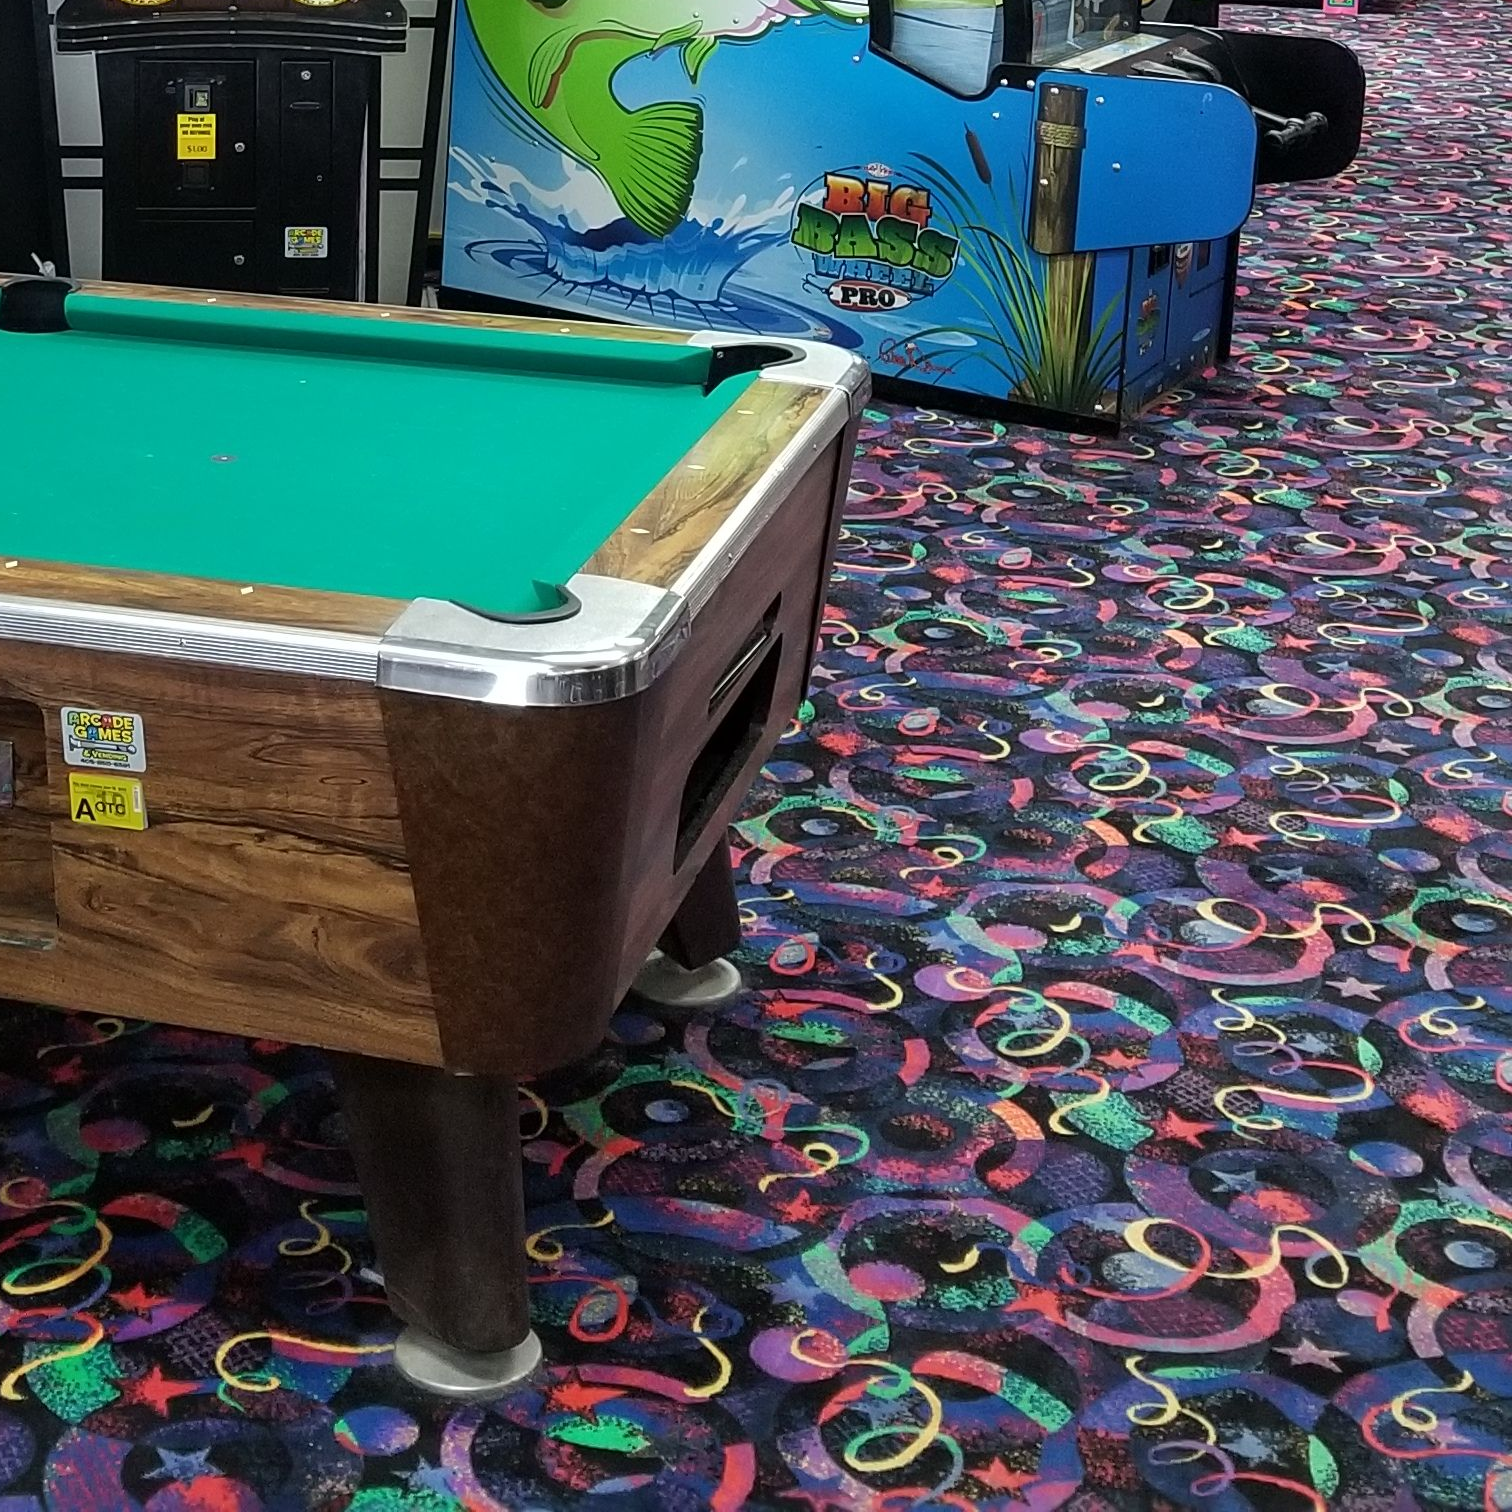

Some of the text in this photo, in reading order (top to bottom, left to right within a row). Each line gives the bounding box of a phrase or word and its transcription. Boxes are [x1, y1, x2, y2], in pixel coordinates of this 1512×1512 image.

[187, 144, 208, 154] $1.00
[823, 172, 933, 229] BIG
[791, 202, 961, 279] BASS
[840, 286, 896, 309] PRO
[67, 711, 135, 731] ARCADE
[74, 726, 134, 744] GAMES
[75, 797, 96, 821] A
